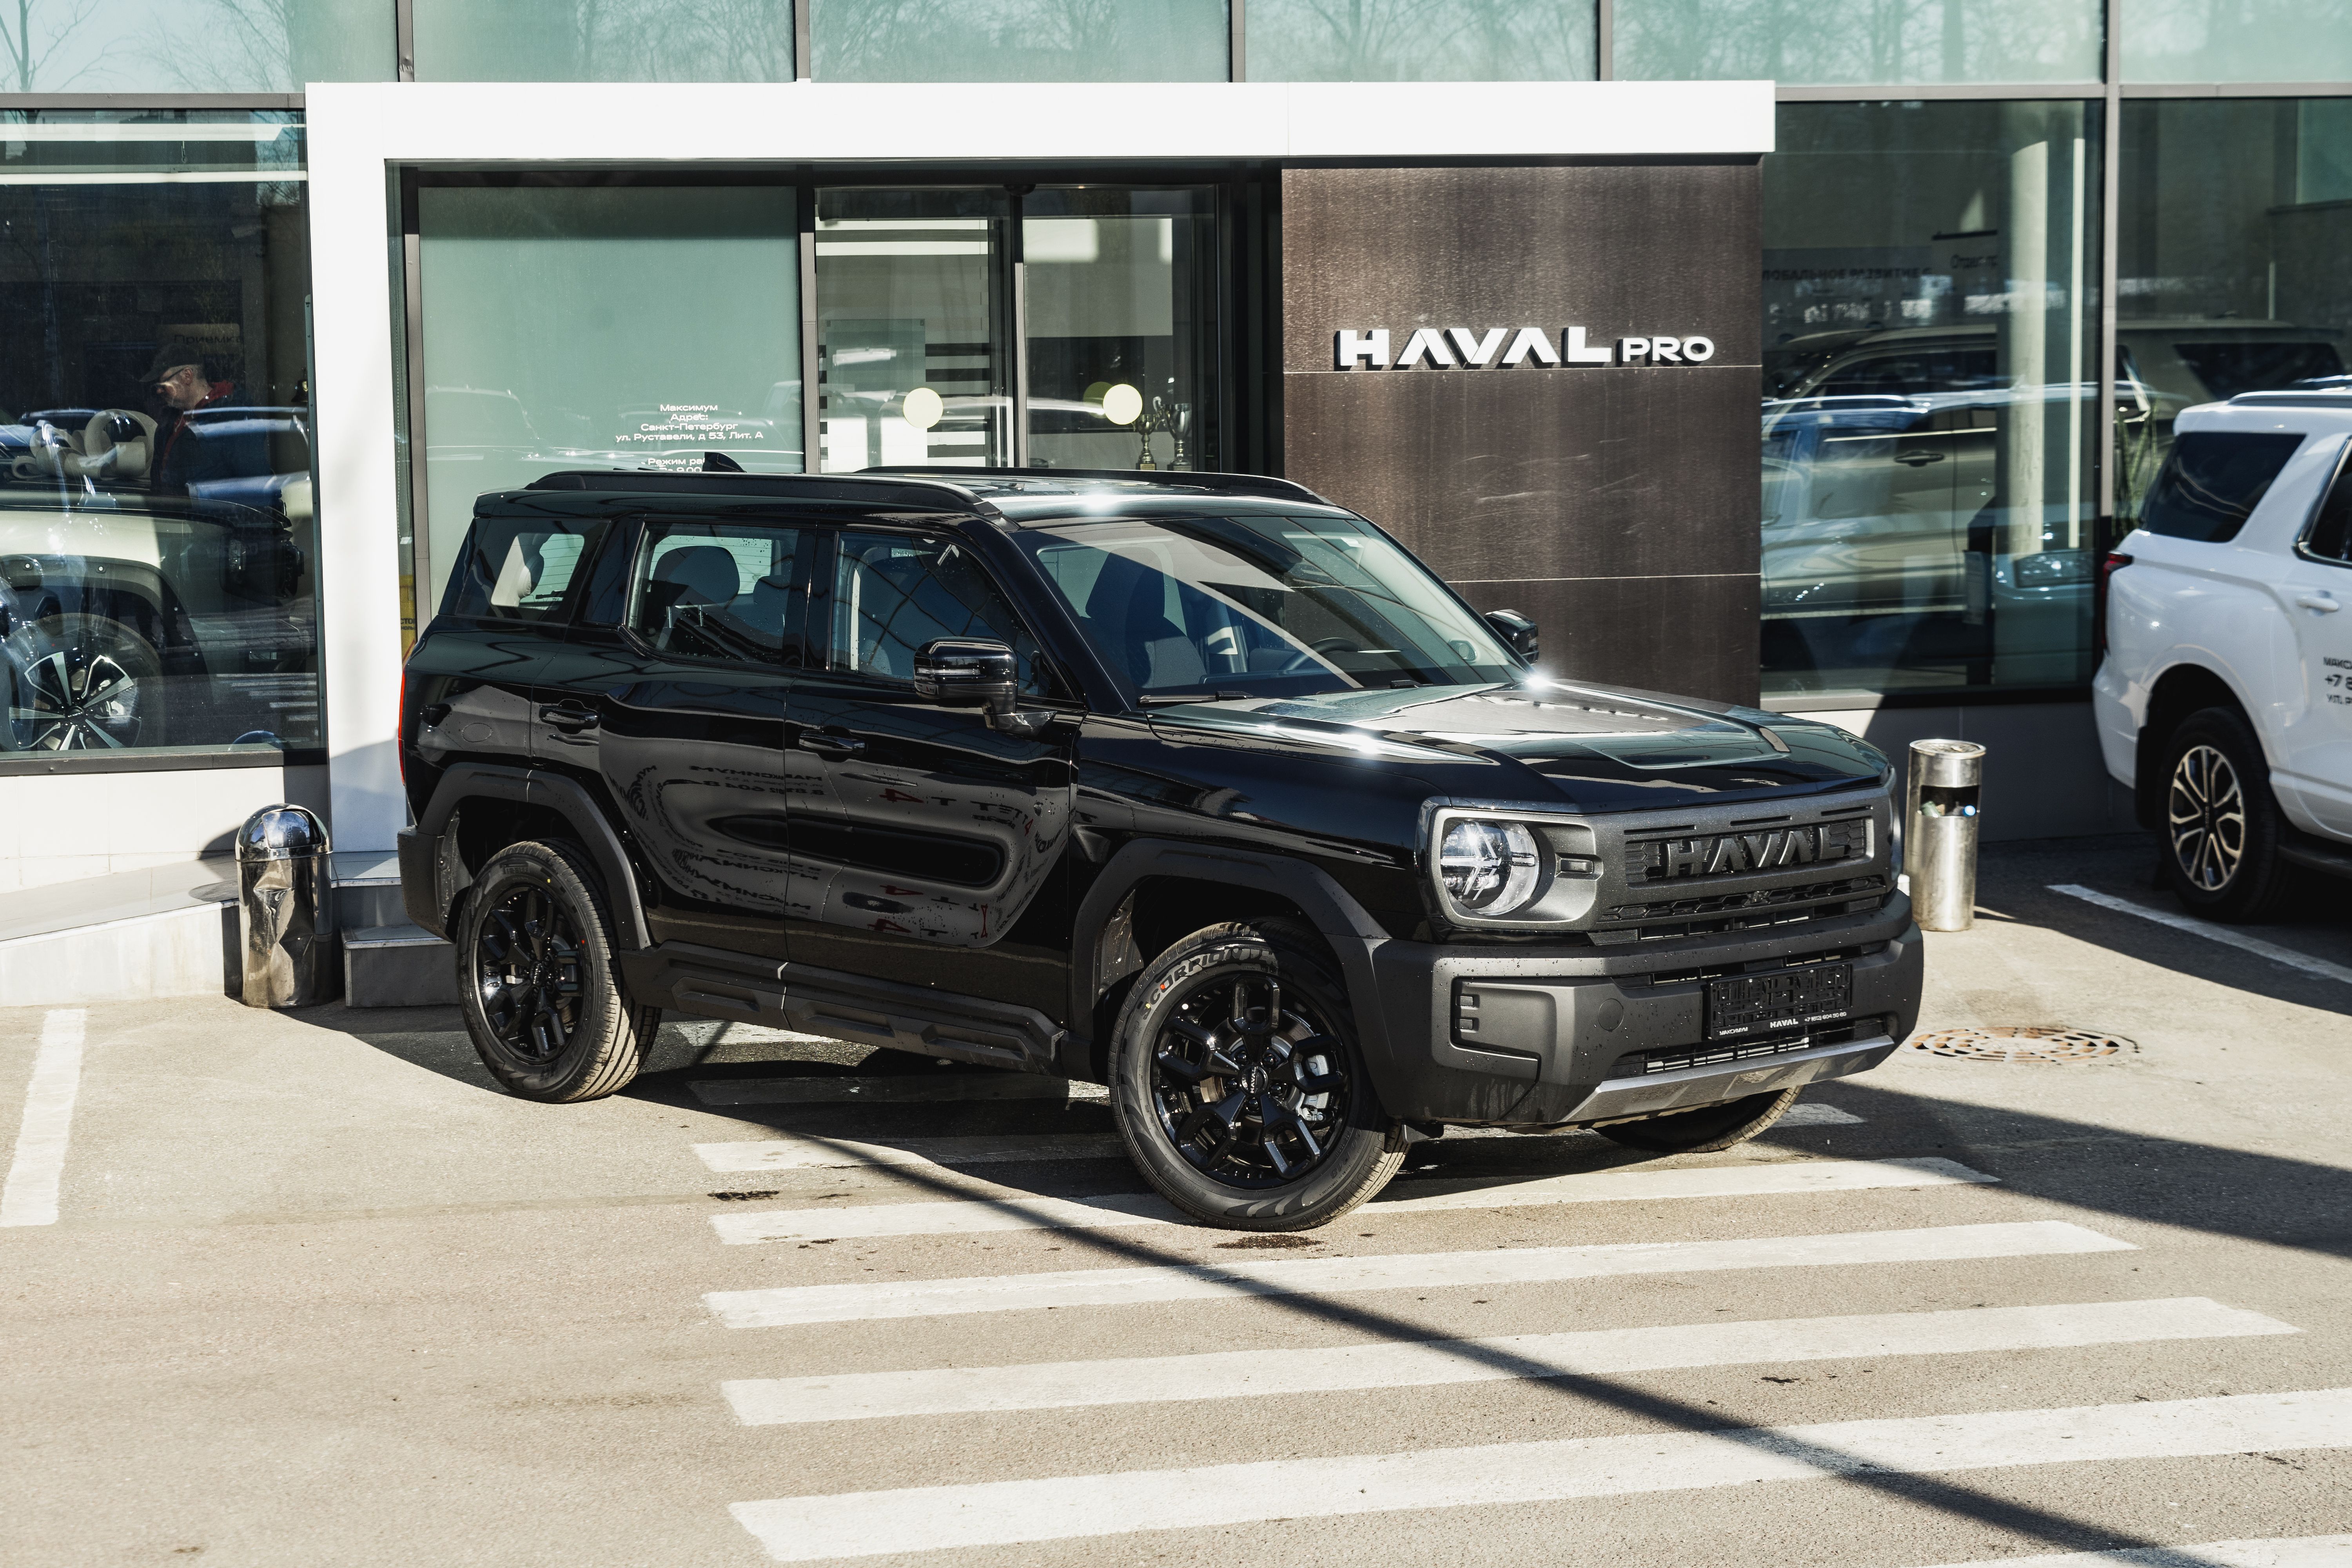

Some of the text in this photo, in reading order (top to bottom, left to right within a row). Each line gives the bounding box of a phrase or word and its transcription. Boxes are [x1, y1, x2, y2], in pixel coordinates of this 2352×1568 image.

[1336, 326, 1715, 367] HAVAL PRO
[670, 414, 708, 422] Адрес:
[641, 423, 738, 432] Санкт-Петербург
[616, 434, 631, 443] ул.
[634, 433, 695, 442] Руставели,
[708, 432, 726, 440] 53,
[2324, 674, 2343, 687] +7
[1666, 826, 1849, 877] HAVAL
[1140, 948, 1243, 1020] SCORPION
[1770, 1018, 1798, 1028] HAVAL
